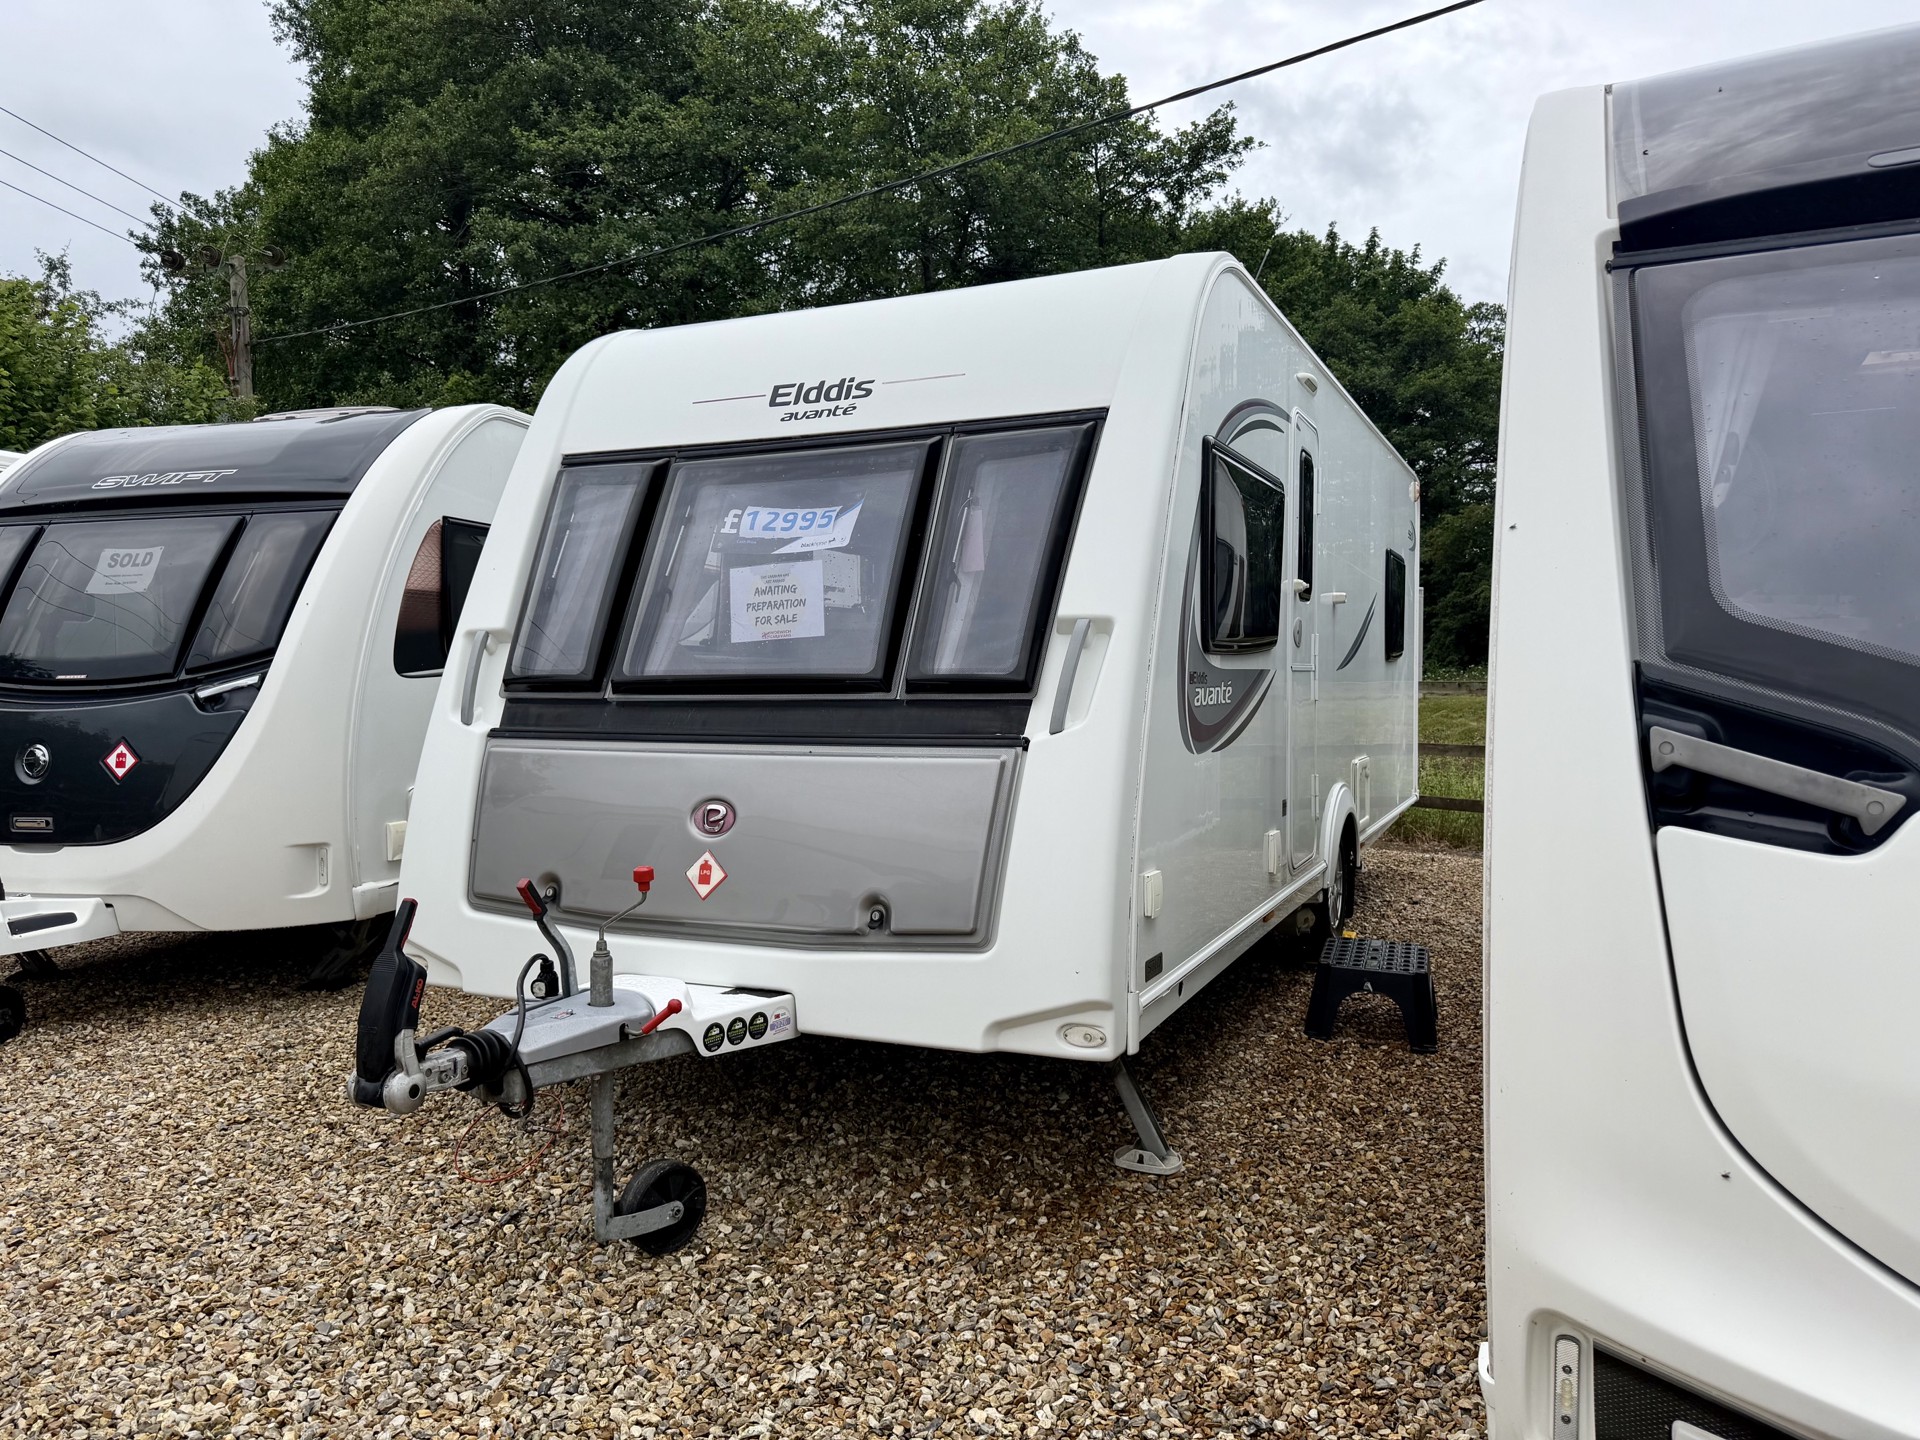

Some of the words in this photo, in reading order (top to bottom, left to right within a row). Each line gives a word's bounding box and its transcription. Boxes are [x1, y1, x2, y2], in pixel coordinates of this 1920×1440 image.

[768, 376, 876, 408] Elddis
[779, 402, 857, 422] avanté
[91, 468, 239, 490] SWIFT
[107, 551, 154, 569] SOLD
[753, 584, 798, 598] AWAITING
[746, 598, 807, 612] PREPARATION
[754, 615, 773, 627] FOR
[774, 613, 798, 625] SALE
[1194, 680, 1233, 707] avanté
